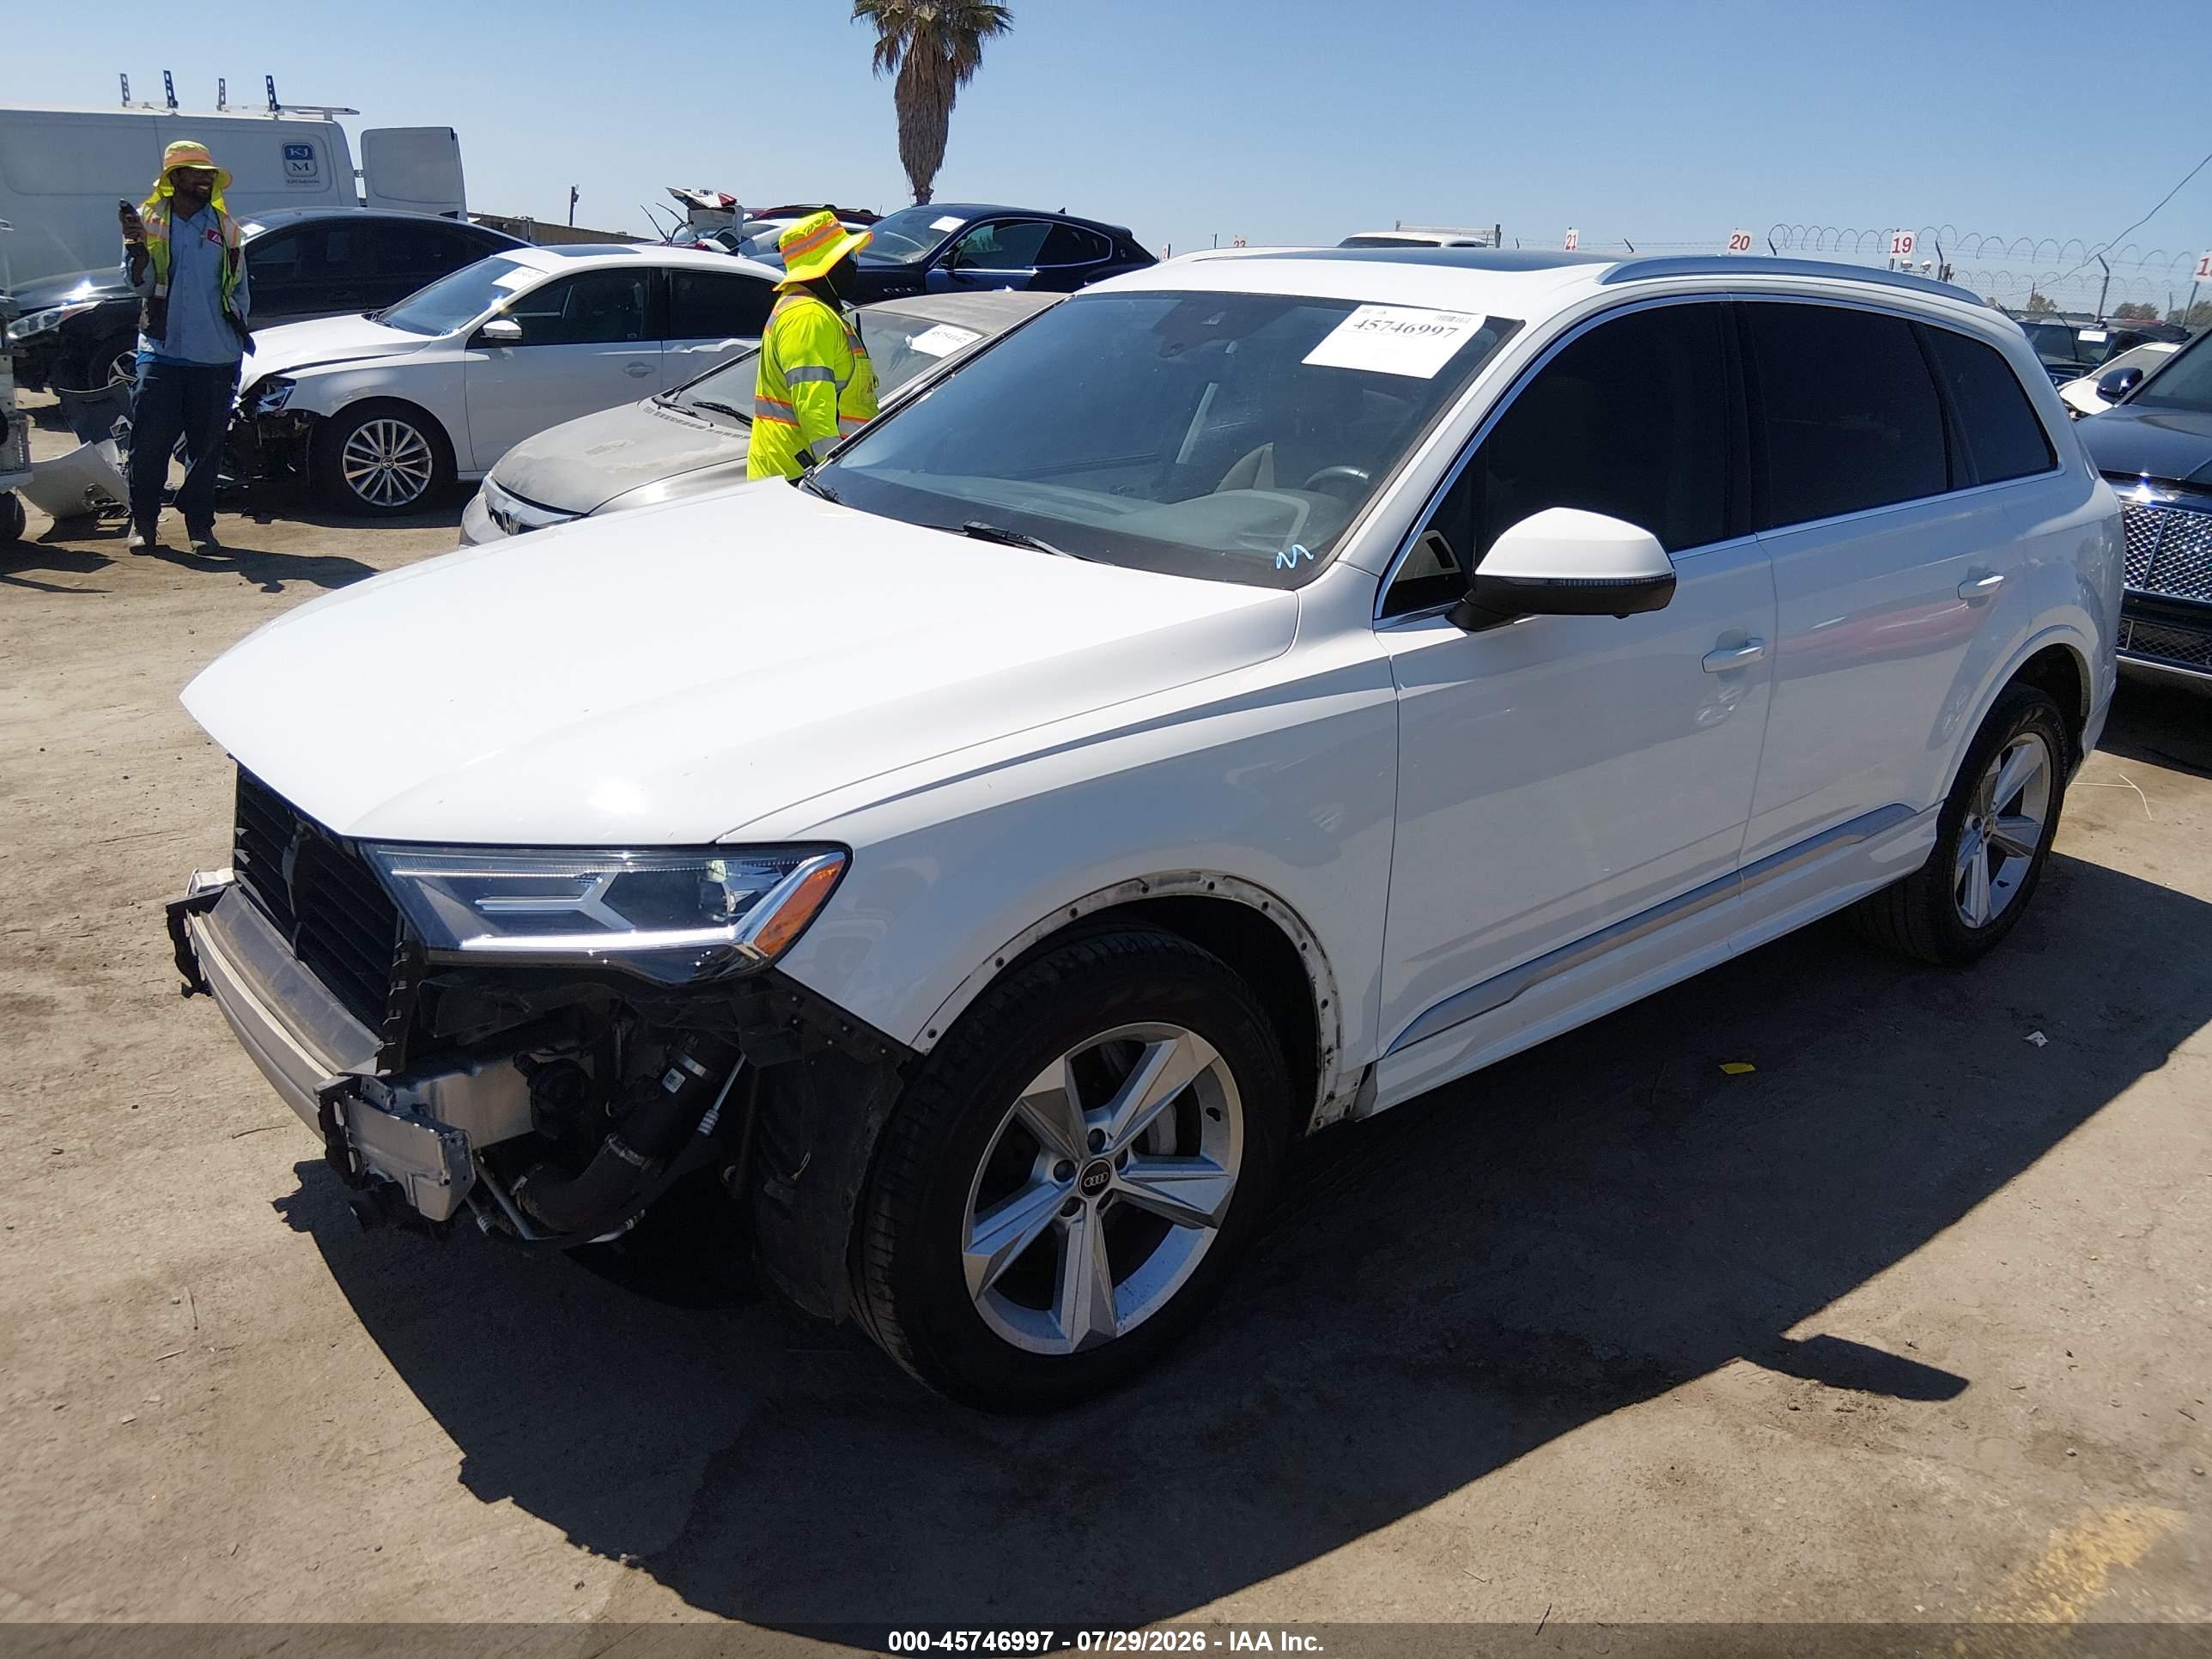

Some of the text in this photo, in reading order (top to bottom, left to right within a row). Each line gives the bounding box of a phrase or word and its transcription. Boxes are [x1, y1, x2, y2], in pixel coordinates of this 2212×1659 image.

[288, 148, 309, 158] KJ
[291, 162, 310, 172] M
[1565, 234, 1577, 251] 21
[1729, 234, 1751, 251] 20
[1891, 236, 1913, 254] 19
[2196, 257, 2212, 276] 1
[1352, 318, 1461, 339] 45746997
